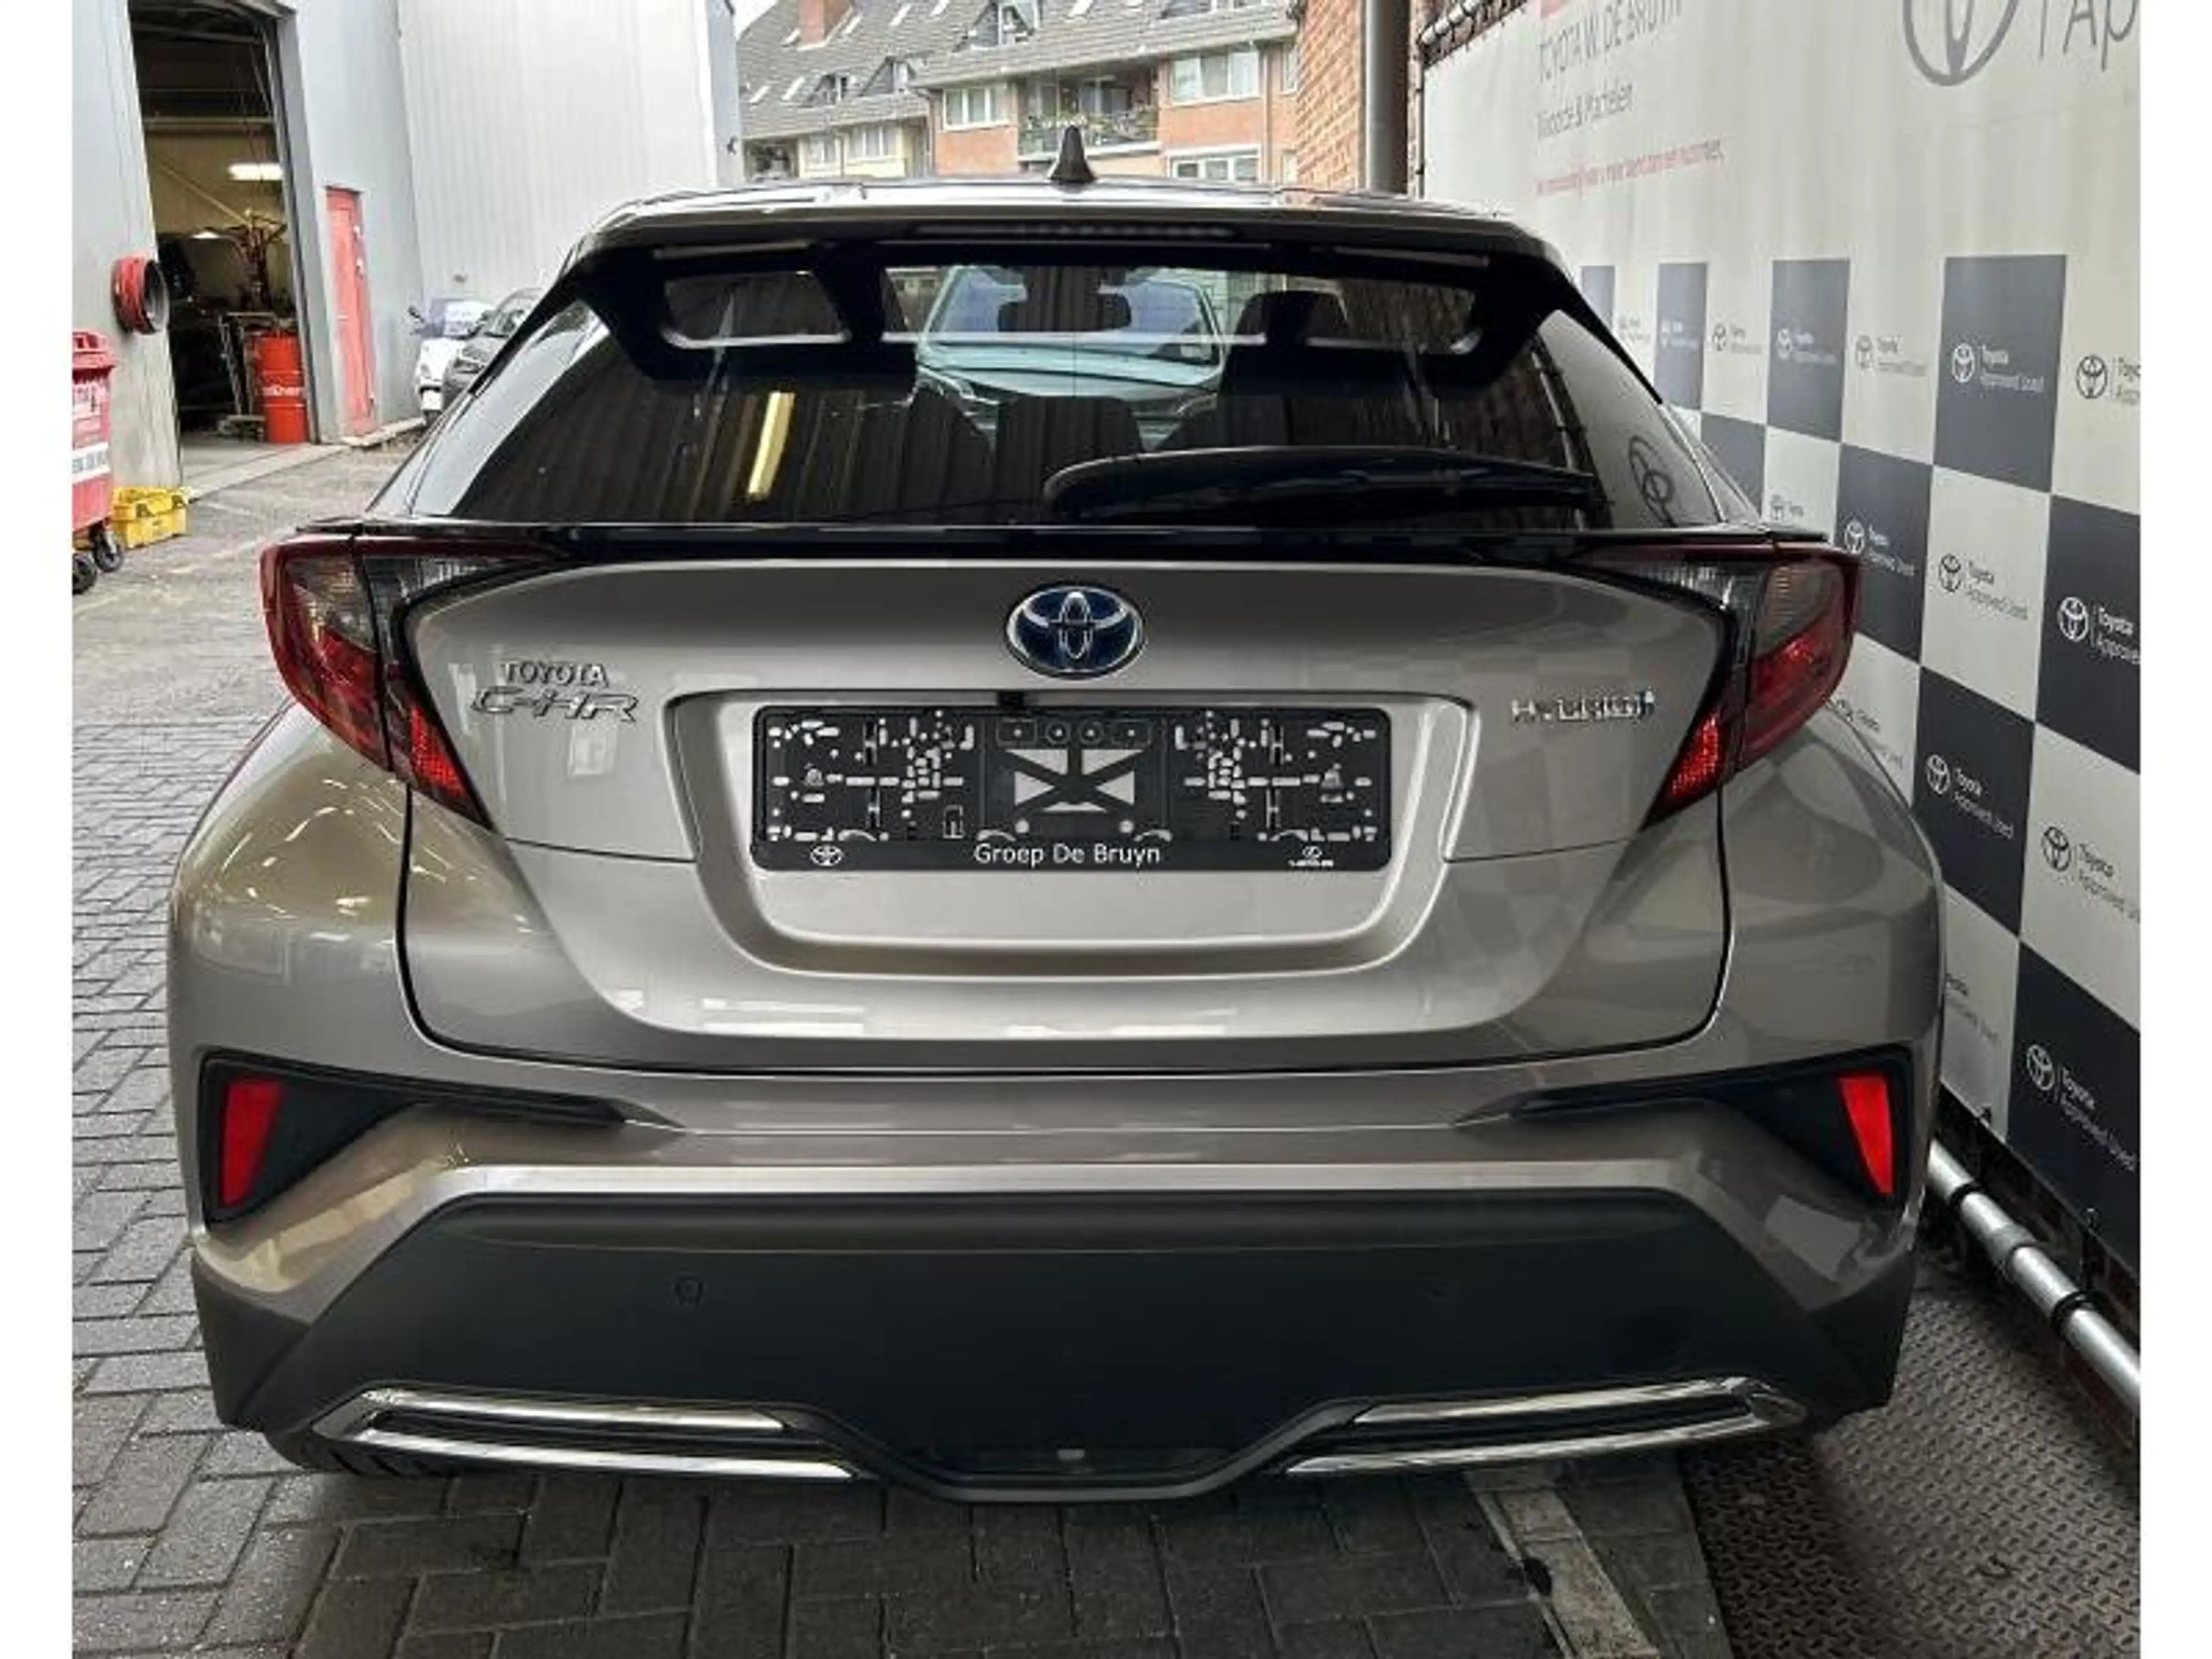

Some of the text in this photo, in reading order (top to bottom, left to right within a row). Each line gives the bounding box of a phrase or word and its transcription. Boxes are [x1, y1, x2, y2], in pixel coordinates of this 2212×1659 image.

[2099, 606, 2134, 636] Toyota
[500, 660, 609, 687] TOYOTA
[470, 685, 640, 723] C-HR
[1953, 767, 1982, 798] Toyota
[974, 843, 1161, 869] Groep De Bruyn
[2078, 843, 2113, 878] Toyota
[2062, 1067, 2096, 1111] Toyota
